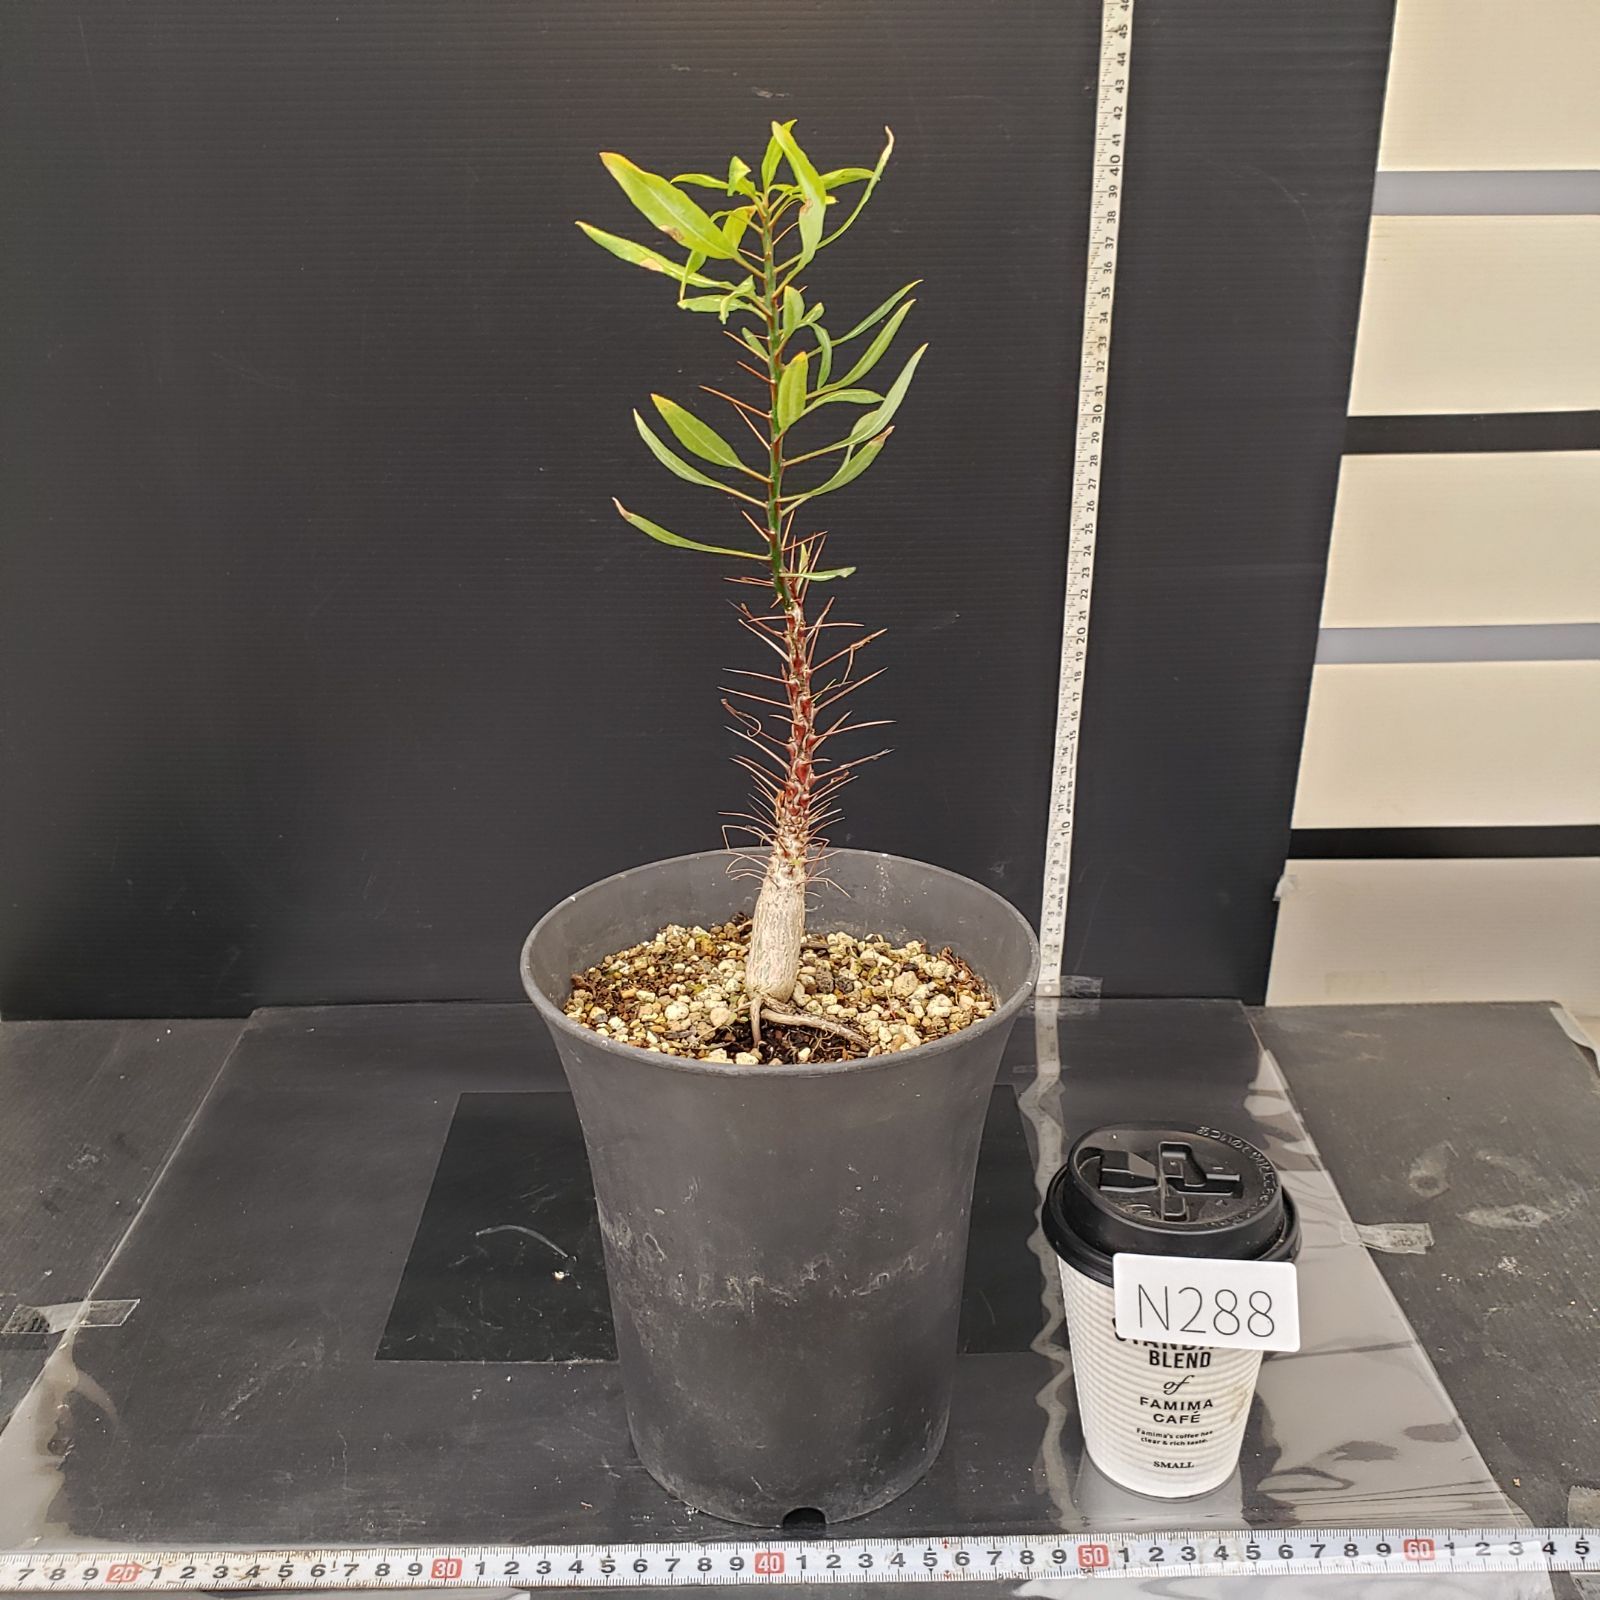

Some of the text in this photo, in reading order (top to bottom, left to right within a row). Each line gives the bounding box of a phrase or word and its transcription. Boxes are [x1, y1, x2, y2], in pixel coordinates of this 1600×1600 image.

[1119, 25, 1128, 39] 45
[1118, 52, 1126, 66] 44
[1116, 79, 1124, 93] 43
[1114, 106, 1123, 120] 42
[1113, 134, 1121, 146] 41
[1110, 155, 1120, 176] 40
[1109, 185, 1117, 198] 39
[1107, 211, 1116, 224] 38
[1105, 236, 1114, 249] 37
[1104, 261, 1112, 274] 36
[1102, 287, 1110, 299] 35
[1100, 312, 1108, 324] 34
[1098, 336, 1107, 348] 33
[1096, 360, 1105, 372] 32
[1095, 385, 1104, 396] 31
[1093, 404, 1102, 423] 30
[1091, 431, 1100, 443] 29
[1090, 454, 1098, 466] 28
[1088, 478, 1097, 489] 27
[1086, 500, 1095, 511] 26
[1085, 523, 1093, 534] 25
[1084, 546, 1091, 556] 24
[1082, 567, 1090, 578] 23
[1080, 588, 1088, 600] 22
[1079, 611, 1087, 621] 21
[1077, 628, 1086, 644] 20
[1076, 652, 1084, 662] 19
[1074, 671, 1082, 681] 18
[1073, 692, 1080, 701] 17
[1070, 710, 1078, 721] 16
[1069, 730, 1076, 740] 15
[1062, 747, 1068, 756] 14
[1060, 766, 1067, 775] 13
[1059, 785, 1066, 794] 12
[1058, 804, 1064, 812] 11
[1061, 821, 1071, 836] 10
[1138, 1283, 1275, 1338] N288
[1150, 1351, 1211, 1368] BLEND
[1163, 1375, 1194, 1395] of
[1140, 1397, 1213, 1410] FAMIMA
[1153, 1411, 1201, 1424] CAFÉ
[1137, 1428, 1173, 1438] Famima's
[18, 1541, 1590, 1582] 7 8 9 20 1 2 3 4 5 6 7 8 9 30 1 2 3 4 5 6 7 8 9 40 1 2 3 4 5 6 7 8 9 50 1 2 3 4 5 6 7 8 9 60 1 2 3 4 5
